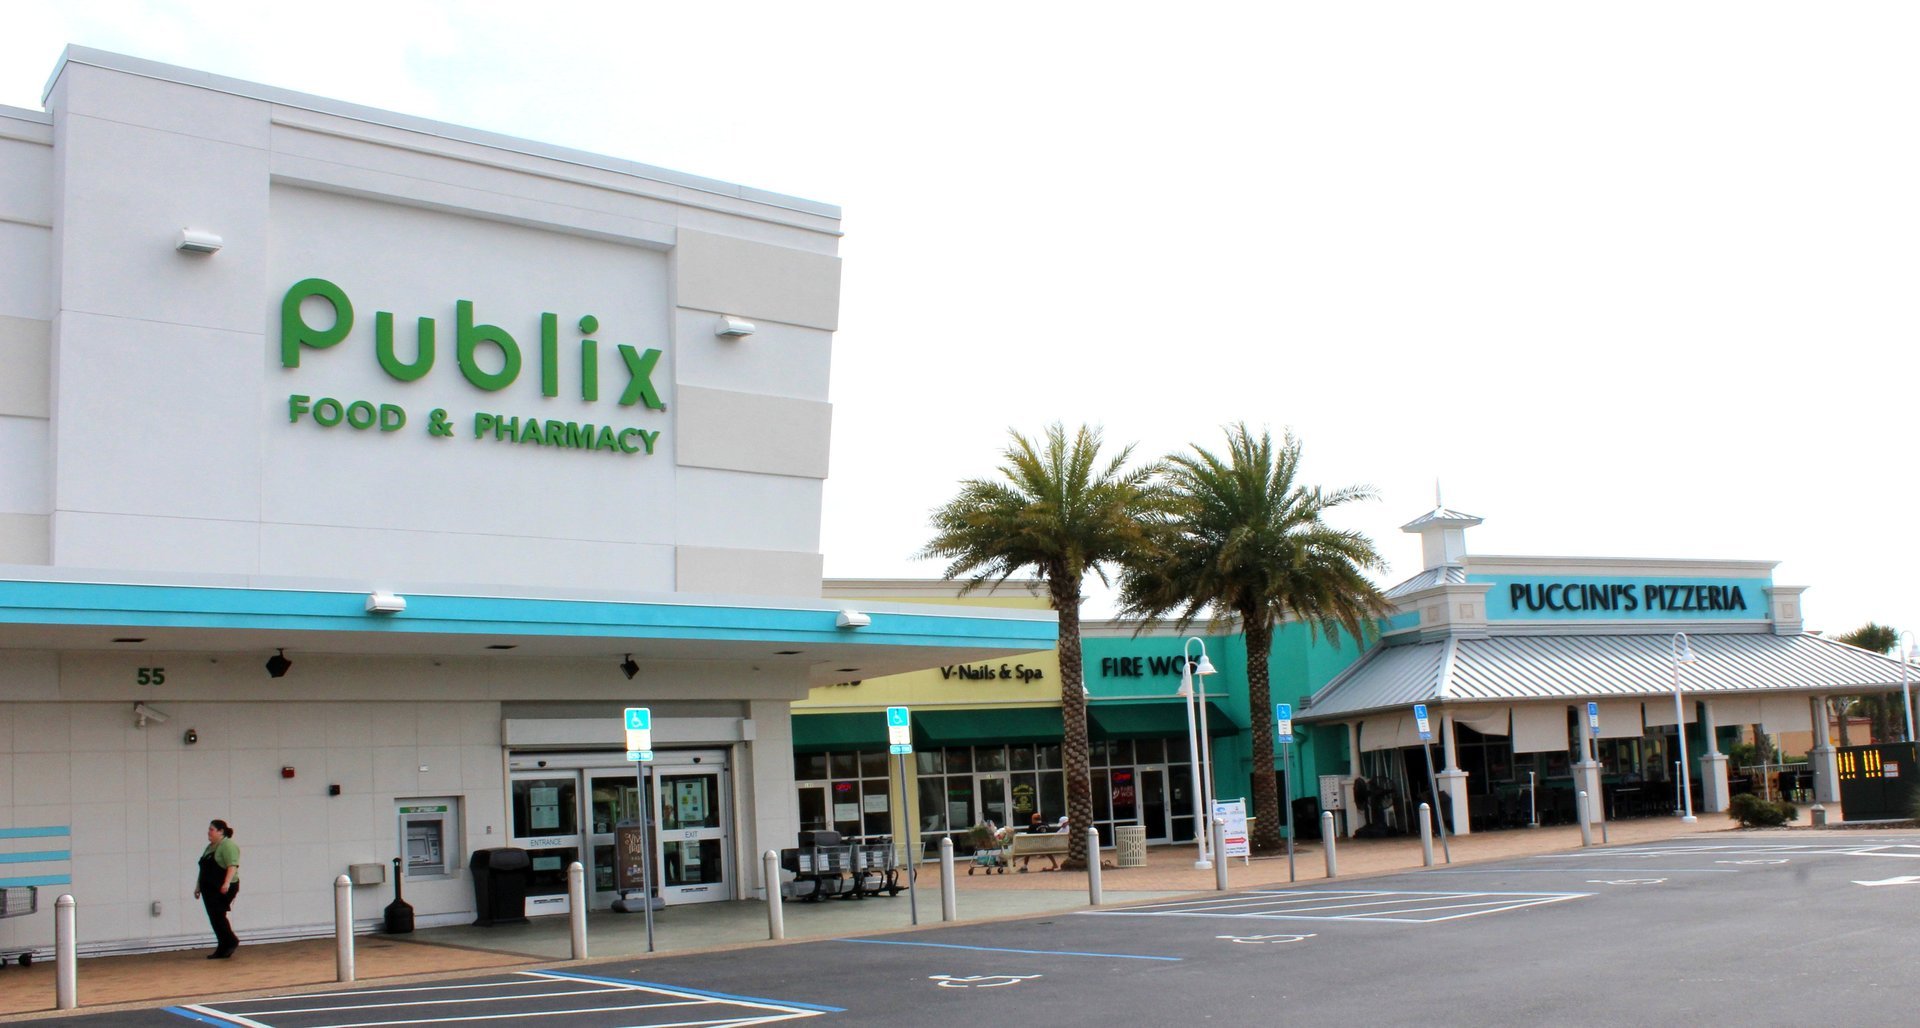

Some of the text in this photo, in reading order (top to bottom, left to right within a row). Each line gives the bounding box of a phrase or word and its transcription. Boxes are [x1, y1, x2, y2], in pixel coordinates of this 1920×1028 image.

[281, 277, 663, 410] Publix
[289, 394, 661, 455] FOOD & PHARMACY
[1510, 583, 1747, 611] PUCCINI'S PIZZERIA
[137, 667, 165, 685] 55
[941, 664, 1044, 684] V-Nails & Spa
[1101, 656, 1143, 678] FIRE
[530, 838, 563, 847] ENTRANCE
[685, 830, 698, 838] EXIT
